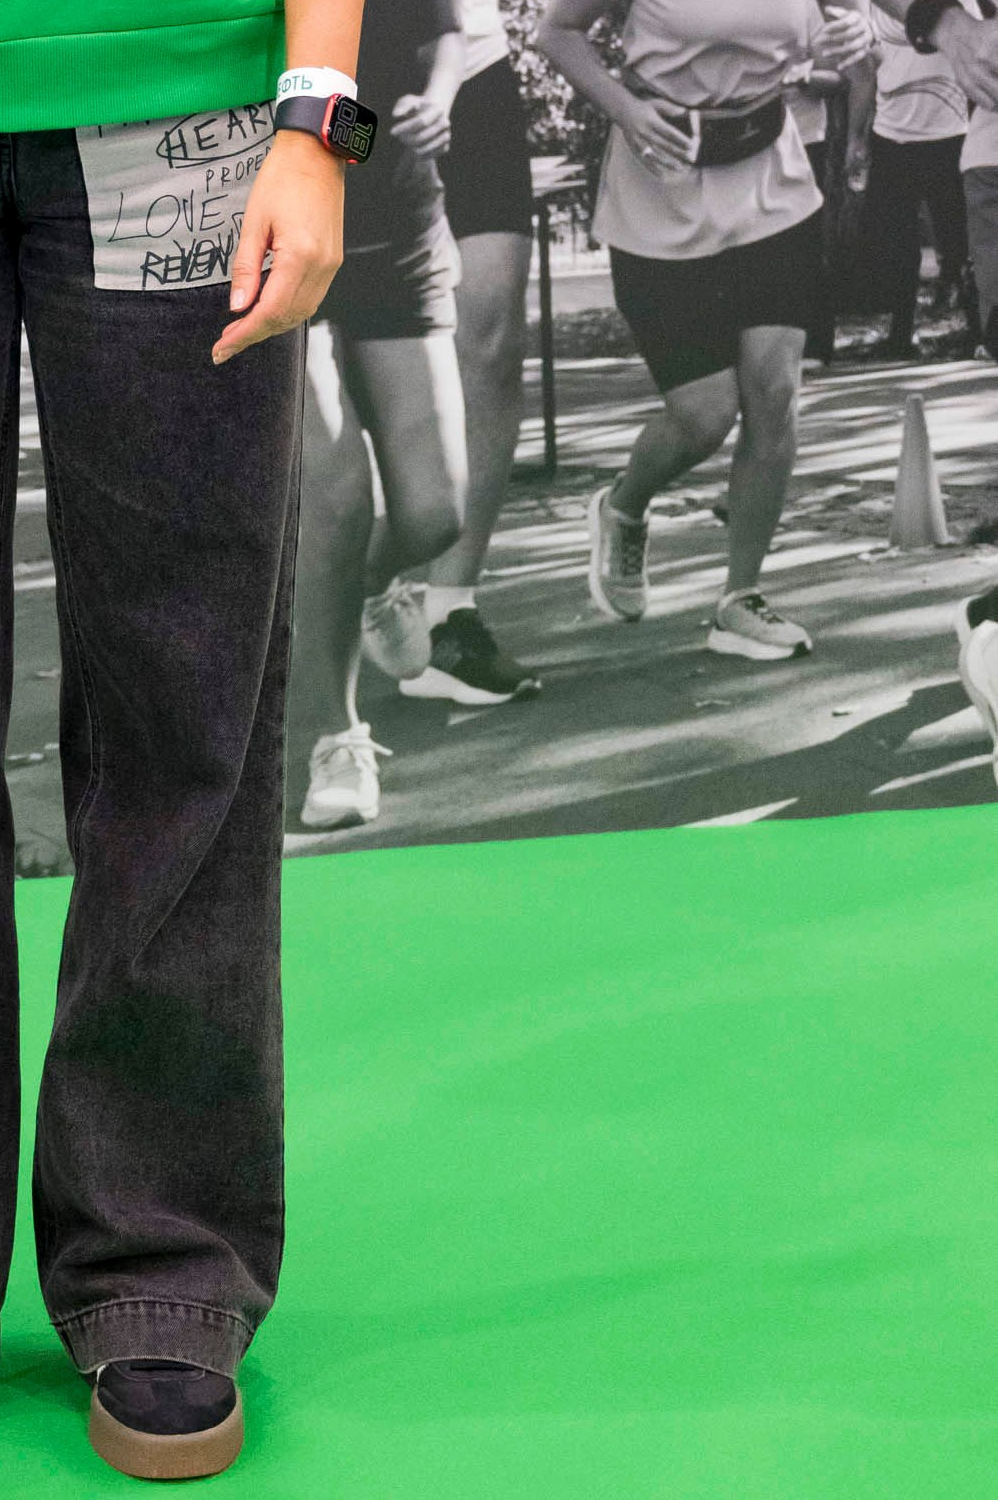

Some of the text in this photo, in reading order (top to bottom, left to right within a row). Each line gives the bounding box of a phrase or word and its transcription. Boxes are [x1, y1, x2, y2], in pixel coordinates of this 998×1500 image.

[278, 75, 313, 92] ФТЬ
[205, 146, 271, 191] PROPE
[107, 190, 229, 243] LOVE
[140, 229, 235, 289] REVEN
